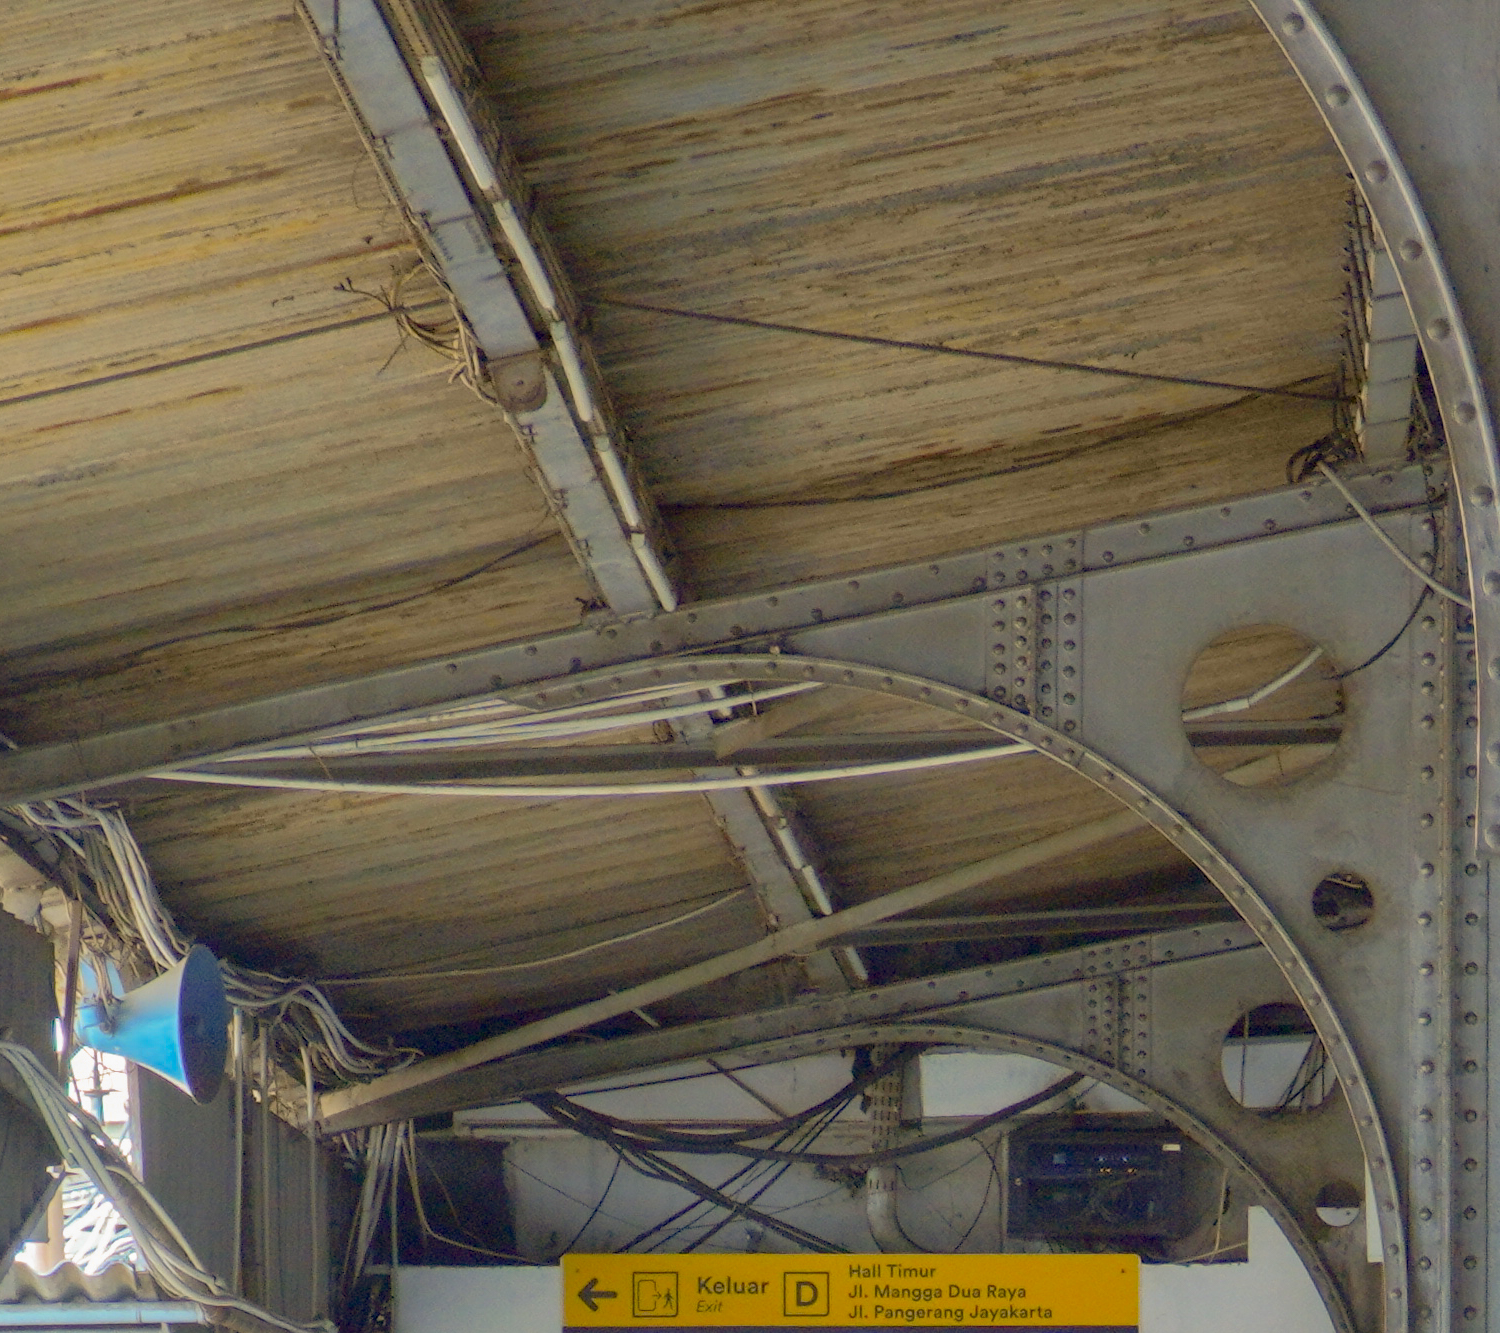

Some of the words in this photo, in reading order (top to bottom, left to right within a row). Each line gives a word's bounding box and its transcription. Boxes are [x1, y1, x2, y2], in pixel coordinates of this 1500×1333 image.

[849, 1264, 881, 1278] Hall
[886, 1264, 936, 1278] Timur
[697, 1276, 769, 1295] Keluar
[795, 1281, 819, 1307] D
[848, 1284, 868, 1299] Jl.
[874, 1284, 942, 1301] Mangga
[948, 1284, 981, 1298] Dua
[987, 1284, 1027, 1301] Raya
[696, 1300, 723, 1313] Exit
[848, 1305, 868, 1319] Jl.
[874, 1305, 964, 1322] Pangerang
[970, 1304, 1053, 1322] Jayakarta
